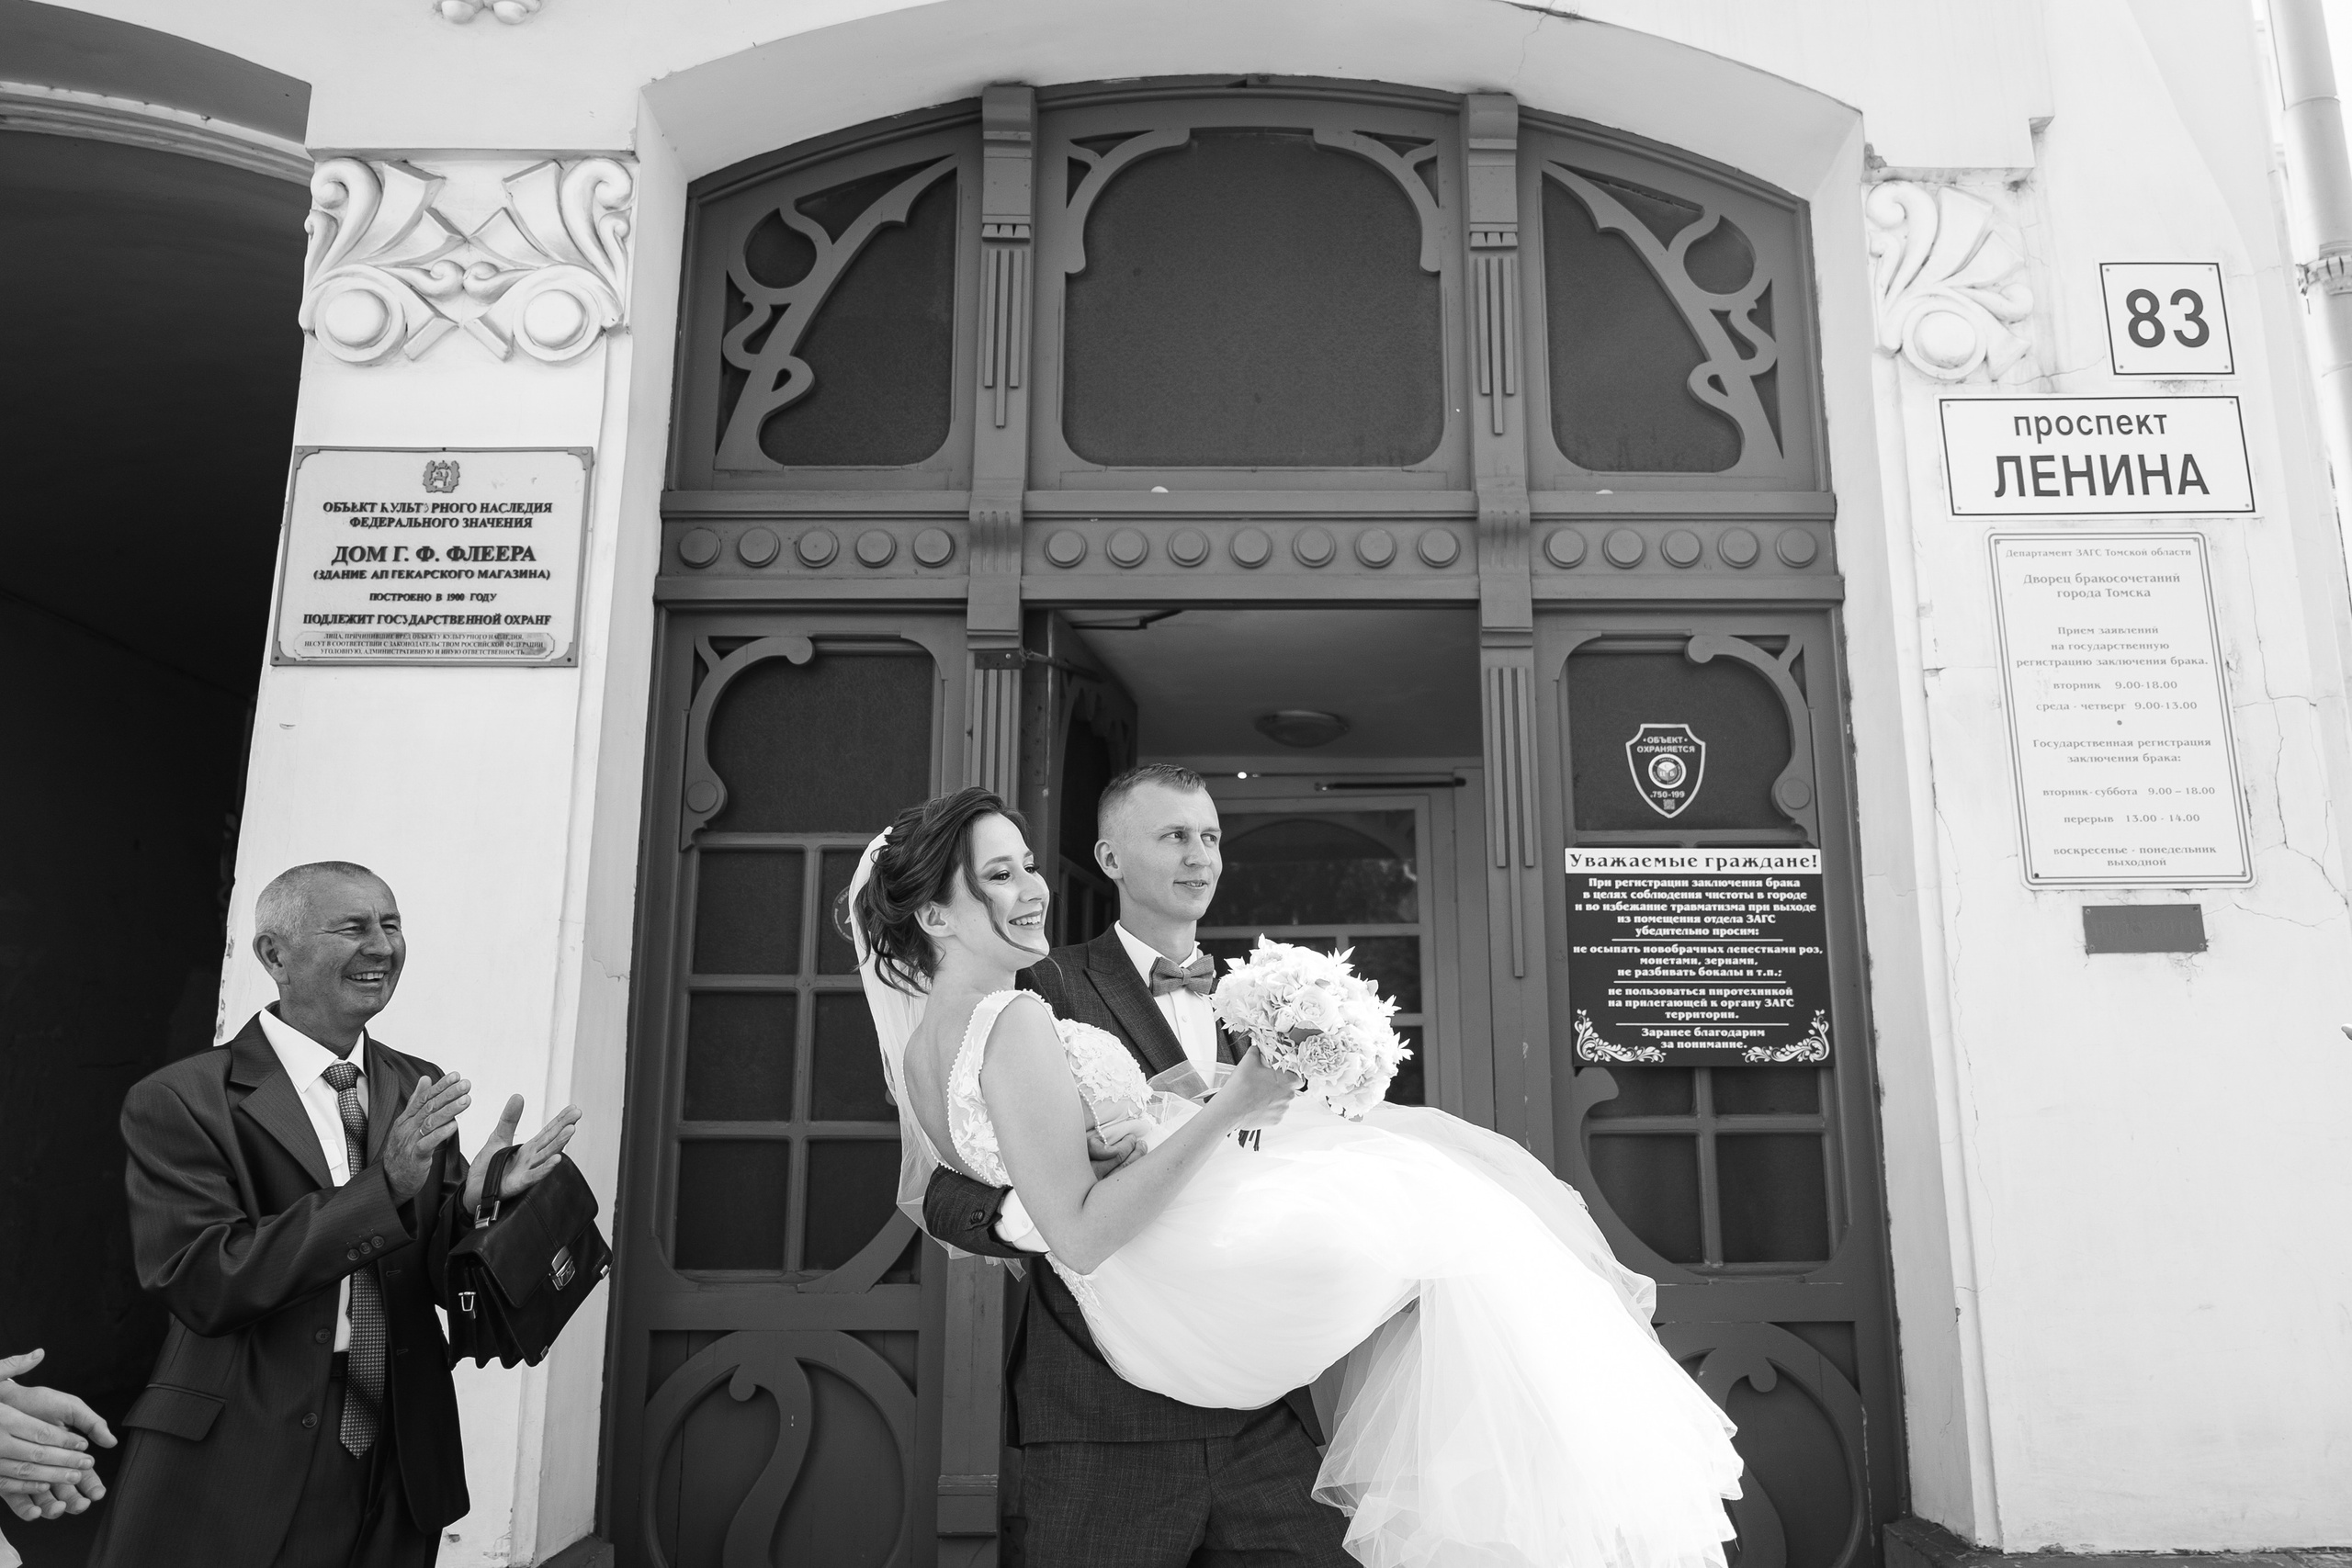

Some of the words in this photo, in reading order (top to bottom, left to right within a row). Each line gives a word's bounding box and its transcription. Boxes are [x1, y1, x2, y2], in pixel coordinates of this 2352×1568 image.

[2126, 288, 2210, 348] 83
[2014, 414, 2167, 444] проспект
[1995, 454, 2210, 498] ЛЕНИНА
[323, 502, 378, 513] ОБЪЕКТ
[480, 502, 553, 515] НАСЛЕДИЯ
[349, 517, 459, 529] ФЕДЕРАЛЬНОГО
[462, 517, 533, 528] ЗНАЧЕНИЯ
[331, 546, 388, 566] ДОМ
[392, 546, 409, 562] Г.
[416, 546, 439, 562] Ф.
[447, 546, 537, 562] ФЛЕЕРА
[2007, 549, 2072, 558] Департамент
[2151, 547, 2191, 556] области
[313, 570, 368, 581] (ЗДАНИЕ
[370, 570, 475, 580] АПТЕКАРСКОГО
[477, 570, 550, 581] МАГАЗИНА)
[2023, 574, 2071, 586] Дворец
[2075, 572, 2180, 585] бракосочетаний
[369, 592, 432, 602] ПОСТРОЕНО
[435, 593, 442, 602] В
[469, 593, 497, 603] ГОДУ
[2057, 590, 2101, 600] города
[2105, 588, 2151, 597] Томска
[303, 614, 375, 626] ПОДЛЕЖИТ
[377, 613, 502, 626] ГОСУДАРСТВЕННОЙ
[2058, 626, 2094, 637] Прием
[2069, 643, 2169, 652] государственную
[2017, 659, 2092, 668] регистрацию
[2171, 655, 2208, 667] брака.
[2053, 682, 2101, 691] вторник
[2115, 681, 2177, 689] 9.00-18.00
[2036, 704, 2069, 712] среда
[2081, 703, 2125, 712] четверг
[2135, 701, 2197, 709] 9.00-13.00
[2033, 739, 2133, 750] Государственная
[2138, 739, 2211, 749] регистрация
[2143, 752, 2180, 764] брака:
[2148, 786, 2172, 795] 9.00
[2187, 786, 2215, 795] 18.00
[2064, 816, 2114, 825] перерыв
[2127, 814, 2156, 822] 13.00
[2170, 813, 2199, 821] 14.00
[2054, 847, 2127, 856] воскресенье
[2140, 846, 2216, 854] понедельник
[1570, 854, 1697, 867] Уважаемые
[1705, 855, 1816, 871] граждане!
[2108, 858, 2166, 866] выходной
[1589, 878, 1611, 889] При
[1615, 880, 1689, 889] регистрации
[1766, 877, 1801, 889] брака
[1593, 892, 1627, 900] целях
[1630, 889, 1702, 900] соблюдения
[1767, 892, 1807, 901] городе
[1602, 901, 1668, 911] избежание
[1670, 904, 1746, 913] травматизма
[1748, 904, 1770, 913] при
[1773, 904, 1816, 912] выходе
[1634, 916, 1701, 924] помещения
[1703, 916, 1743, 924] отдела
[1746, 914, 1776, 923] ЗАГС
[1635, 925, 1710, 937] убедительно
[1713, 929, 1759, 938] просим:
[1644, 943, 1724, 955] новобрачных
[1799, 947, 1823, 955] роз,
[1704, 958, 1758, 966] зернами,
[1634, 966, 1696, 978] разбивать
[1698, 966, 1744, 976] бокалы
[1709, 987, 1792, 998] пиротехникой
[1625, 998, 1707, 1009] прилегающей
[1721, 1000, 1761, 1009] органу
[1765, 998, 1794, 1007] ЗАГС
[1665, 1011, 1739, 1021] территории.
[1642, 1028, 1691, 1039] Заранее
[1694, 1027, 1765, 1039] благодарим
